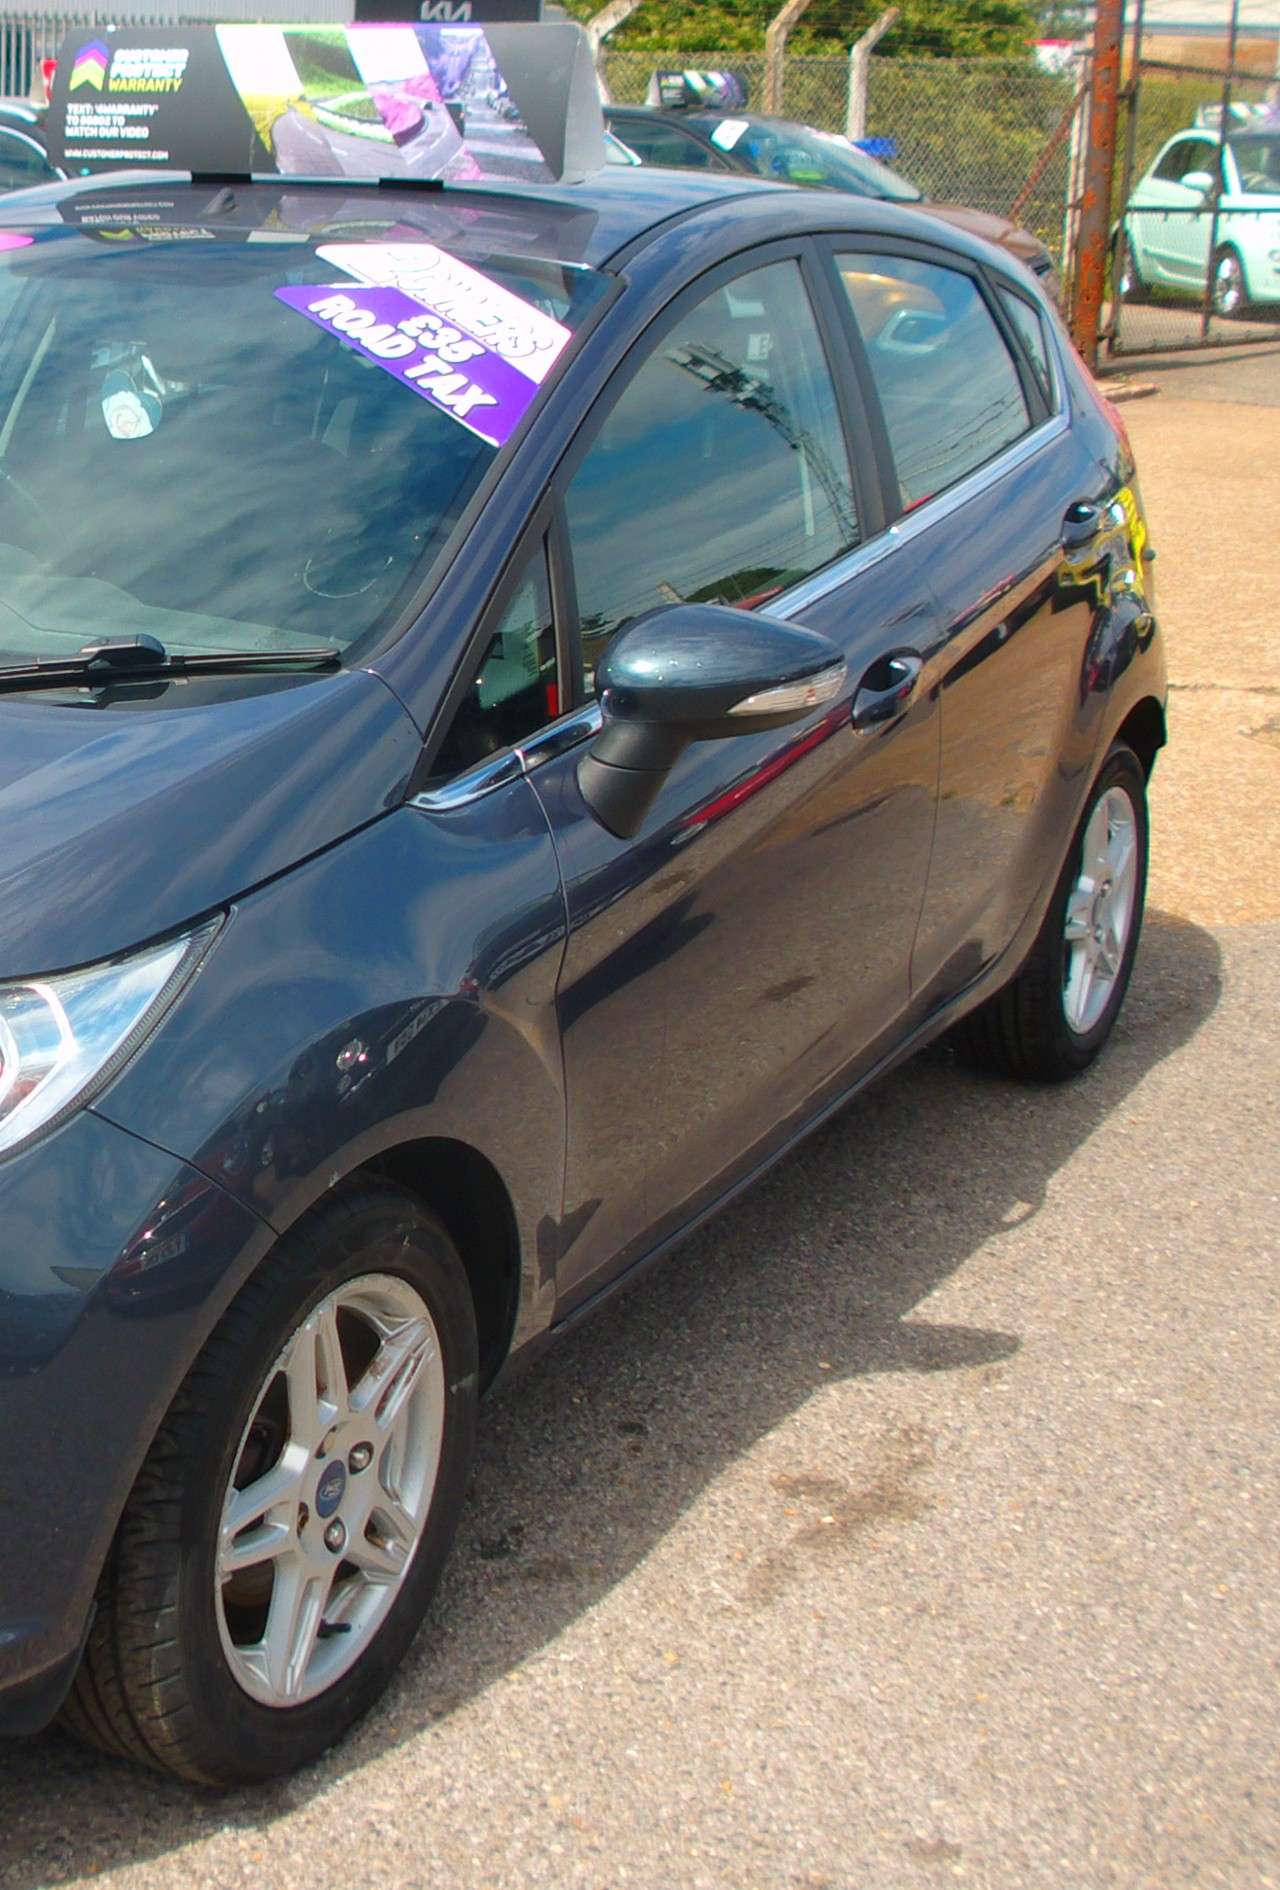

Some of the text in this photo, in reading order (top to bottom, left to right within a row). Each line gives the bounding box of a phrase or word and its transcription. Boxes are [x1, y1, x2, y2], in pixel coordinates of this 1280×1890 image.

[108, 78, 183, 92] WARRANTY
[66, 115, 79, 127] TO
[112, 115, 126, 127] TO
[65, 126, 150, 139] WATCH OUR VIDEO
[398, 314, 487, 363] £35
[307, 294, 499, 417] ROAD TAX
